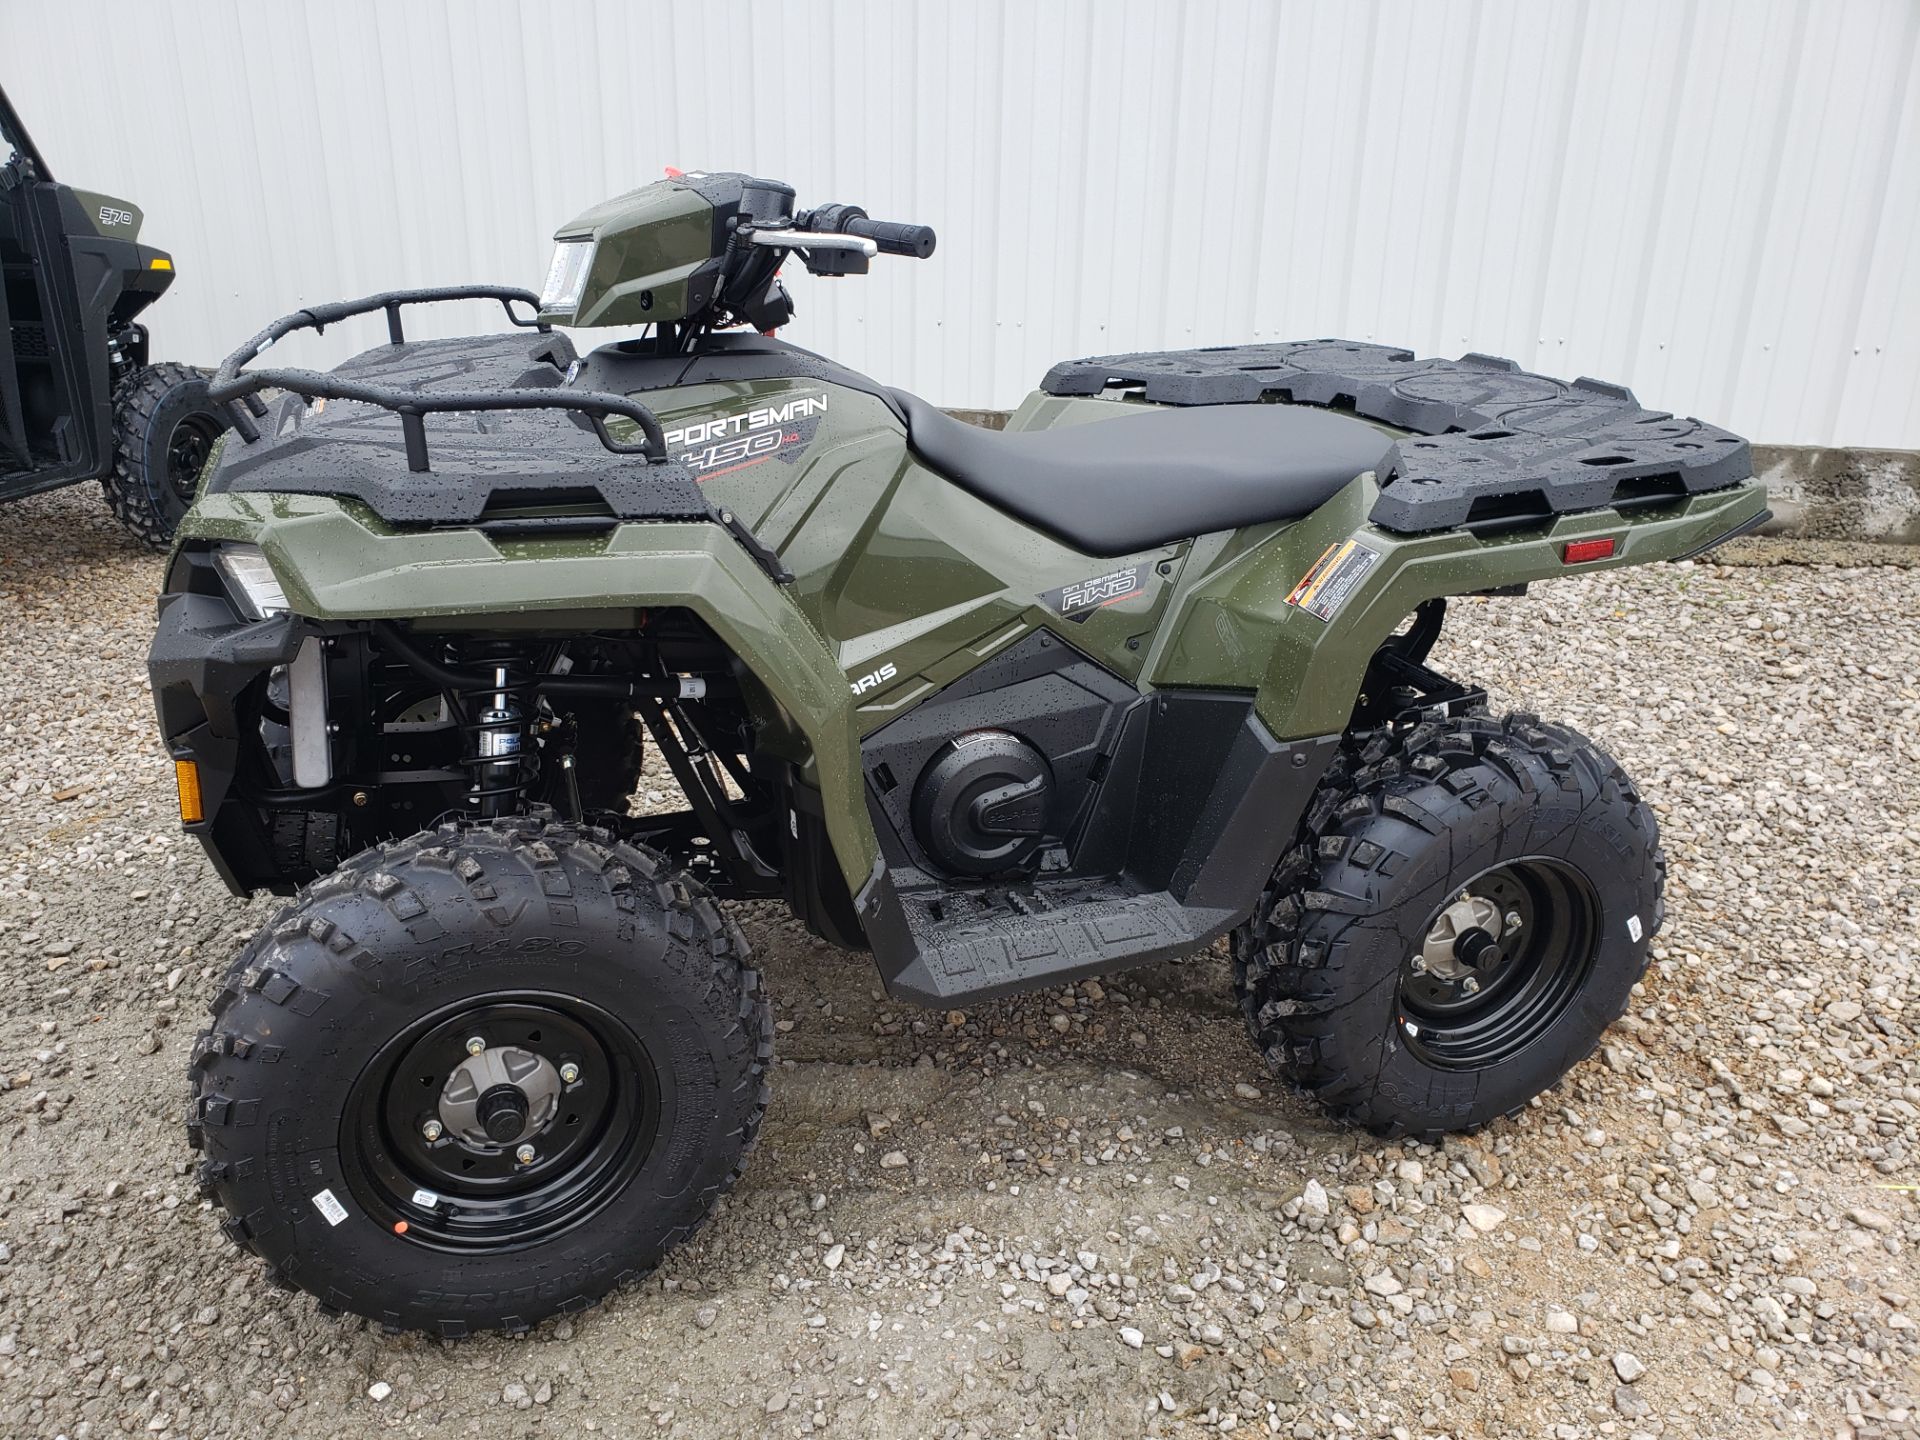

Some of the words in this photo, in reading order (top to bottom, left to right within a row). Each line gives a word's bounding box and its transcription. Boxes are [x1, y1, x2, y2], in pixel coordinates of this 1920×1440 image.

[99, 206, 132, 225] 570
[641, 393, 829, 450] PORTSMAN
[680, 428, 783, 470] 450
[1062, 584, 1080, 595] ON
[1084, 567, 1137, 588] DEMAND
[1062, 575, 1137, 611] AWD
